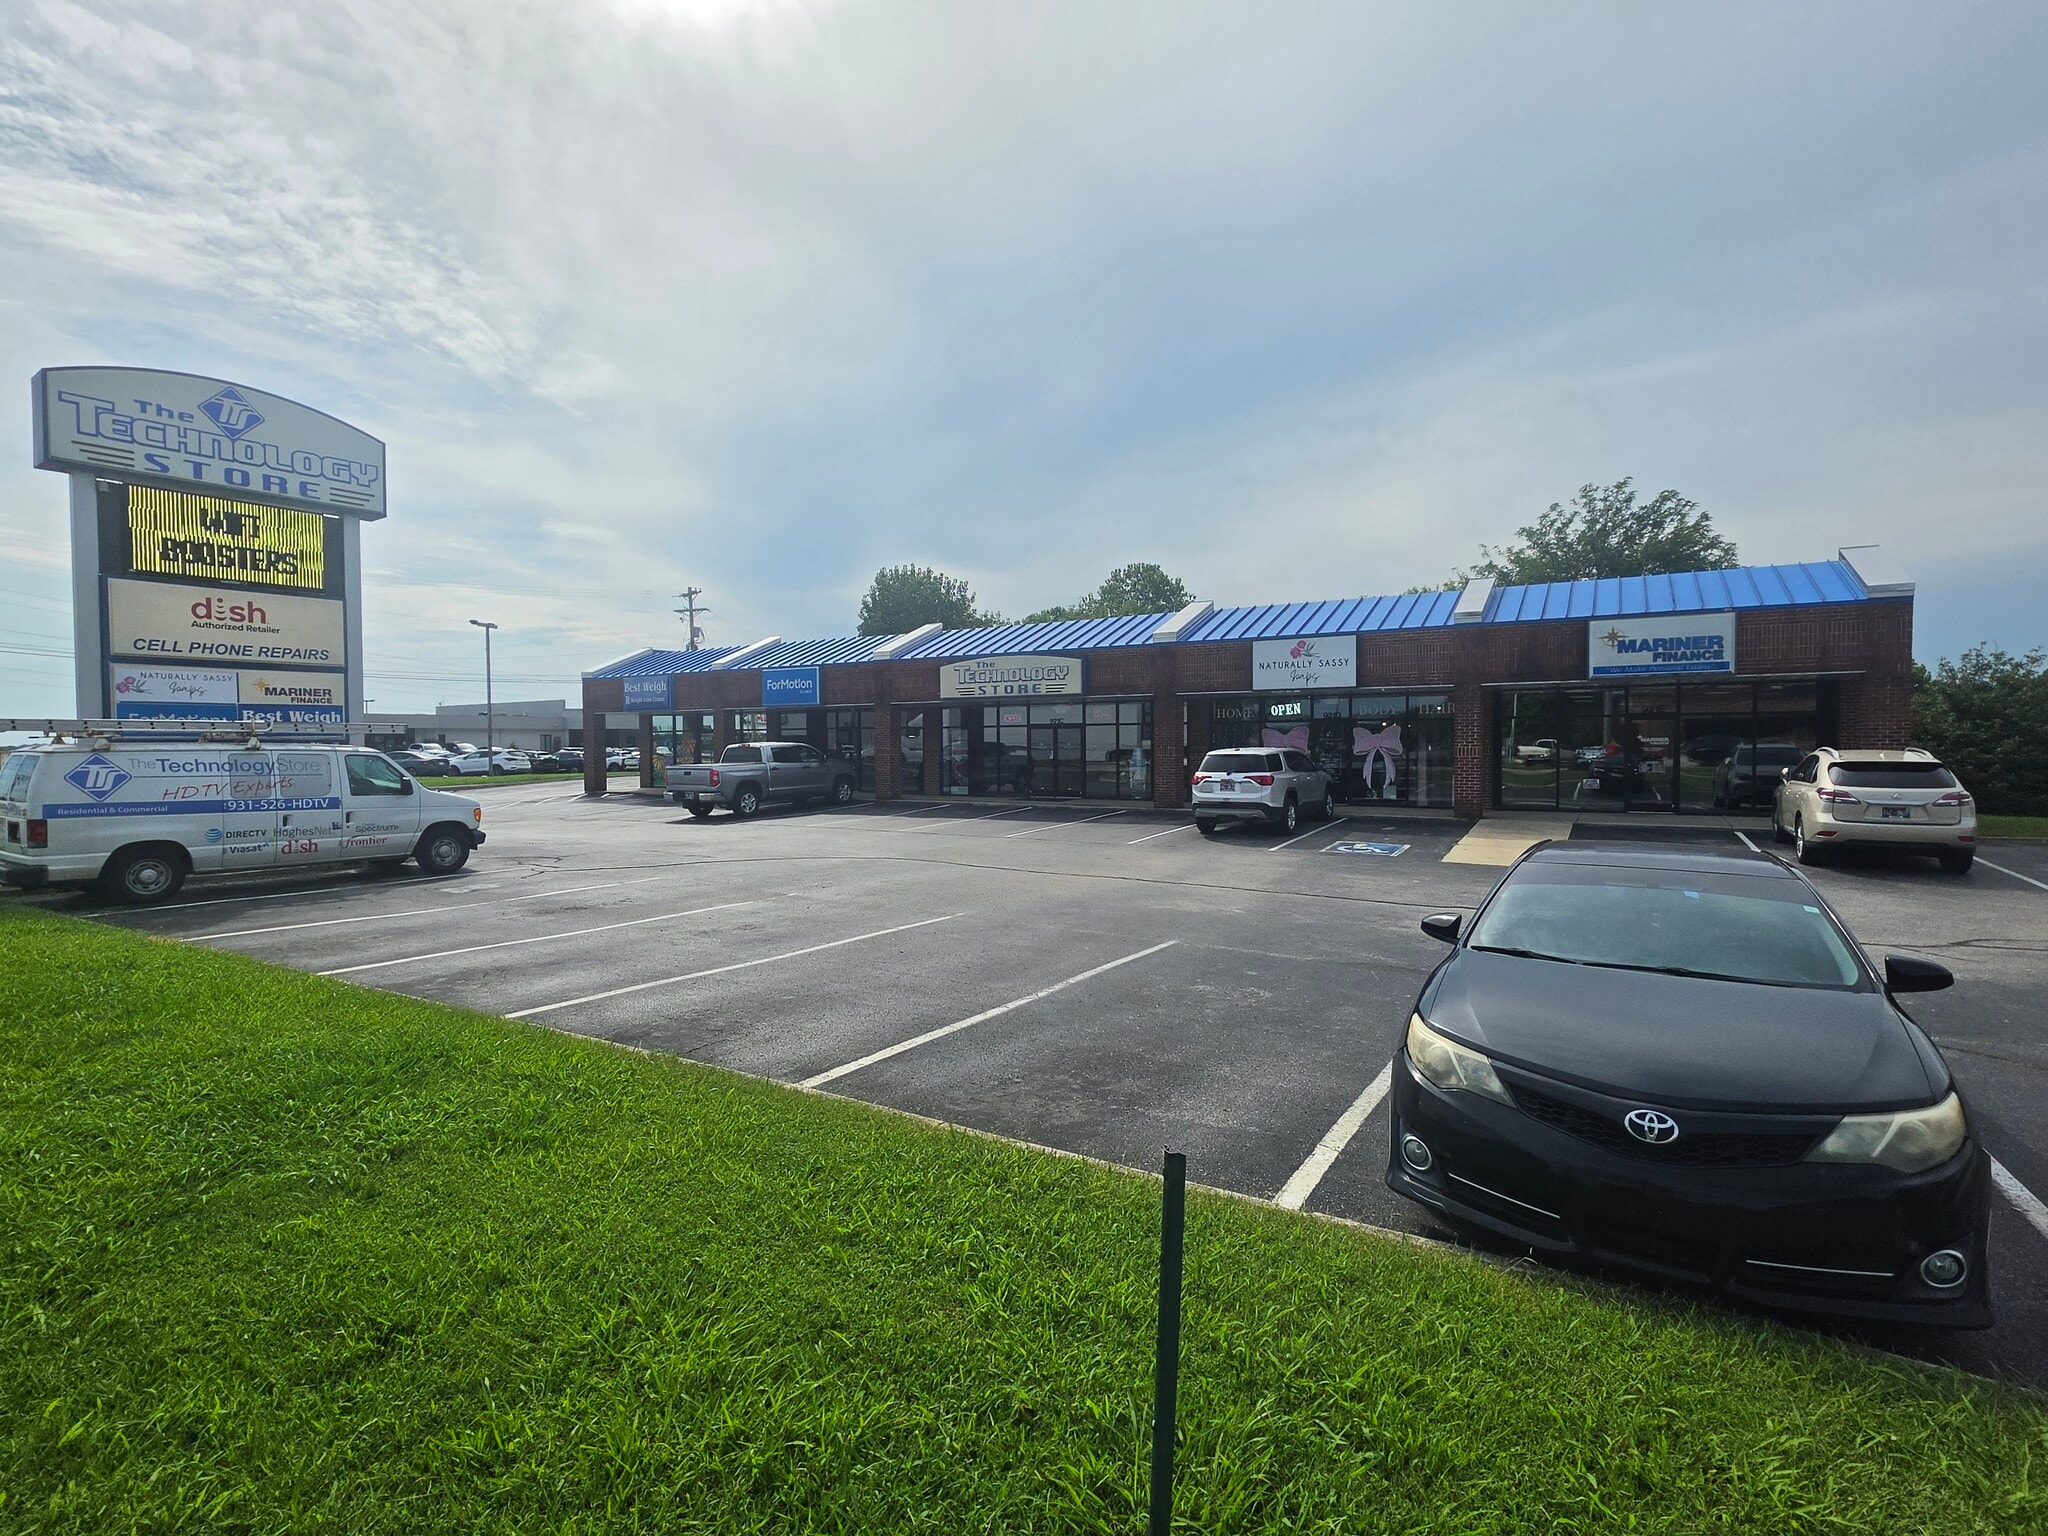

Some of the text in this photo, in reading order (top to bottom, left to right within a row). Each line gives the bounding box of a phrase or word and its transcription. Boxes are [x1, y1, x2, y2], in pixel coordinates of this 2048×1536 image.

[133, 399, 194, 423] The
[57, 390, 379, 488] TECHNOLOGY
[144, 452, 321, 500] STORE
[160, 537, 297, 576] BOOSTERS
[191, 597, 267, 624] dish
[191, 620, 280, 634] Authorized Retailer
[132, 638, 330, 661] CELL PHONE REPAIRS
[1617, 635, 1724, 654] MARINER
[1653, 649, 1724, 663] FINANCE
[1259, 657, 1350, 670] NATURALLY SASSY
[140, 671, 233, 682] NATURALLY SASSY
[954, 665, 1070, 684] TECHNOLOGY
[624, 680, 667, 694] Best Weigh
[767, 679, 813, 690] ForMotion
[978, 684, 1042, 695] STORE
[264, 686, 332, 698] MARINER
[1217, 707, 1255, 718] HOME
[1271, 703, 1301, 716] OPEN
[1359, 703, 1397, 716] BODY
[242, 710, 342, 724] Best Weigh
[127, 758, 321, 775] The Technology Store
[162, 782, 229, 800] HDTV
[57, 807, 108, 816] Residential
[117, 805, 168, 814] Commercial
[228, 798, 329, 811] 931-526-HDTV
[225, 829, 267, 839] DIRECTV
[273, 826, 332, 839] HughesNet
[355, 825, 396, 833] Spectrum
[229, 844, 262, 854] Viasat
[281, 839, 319, 855] dish
